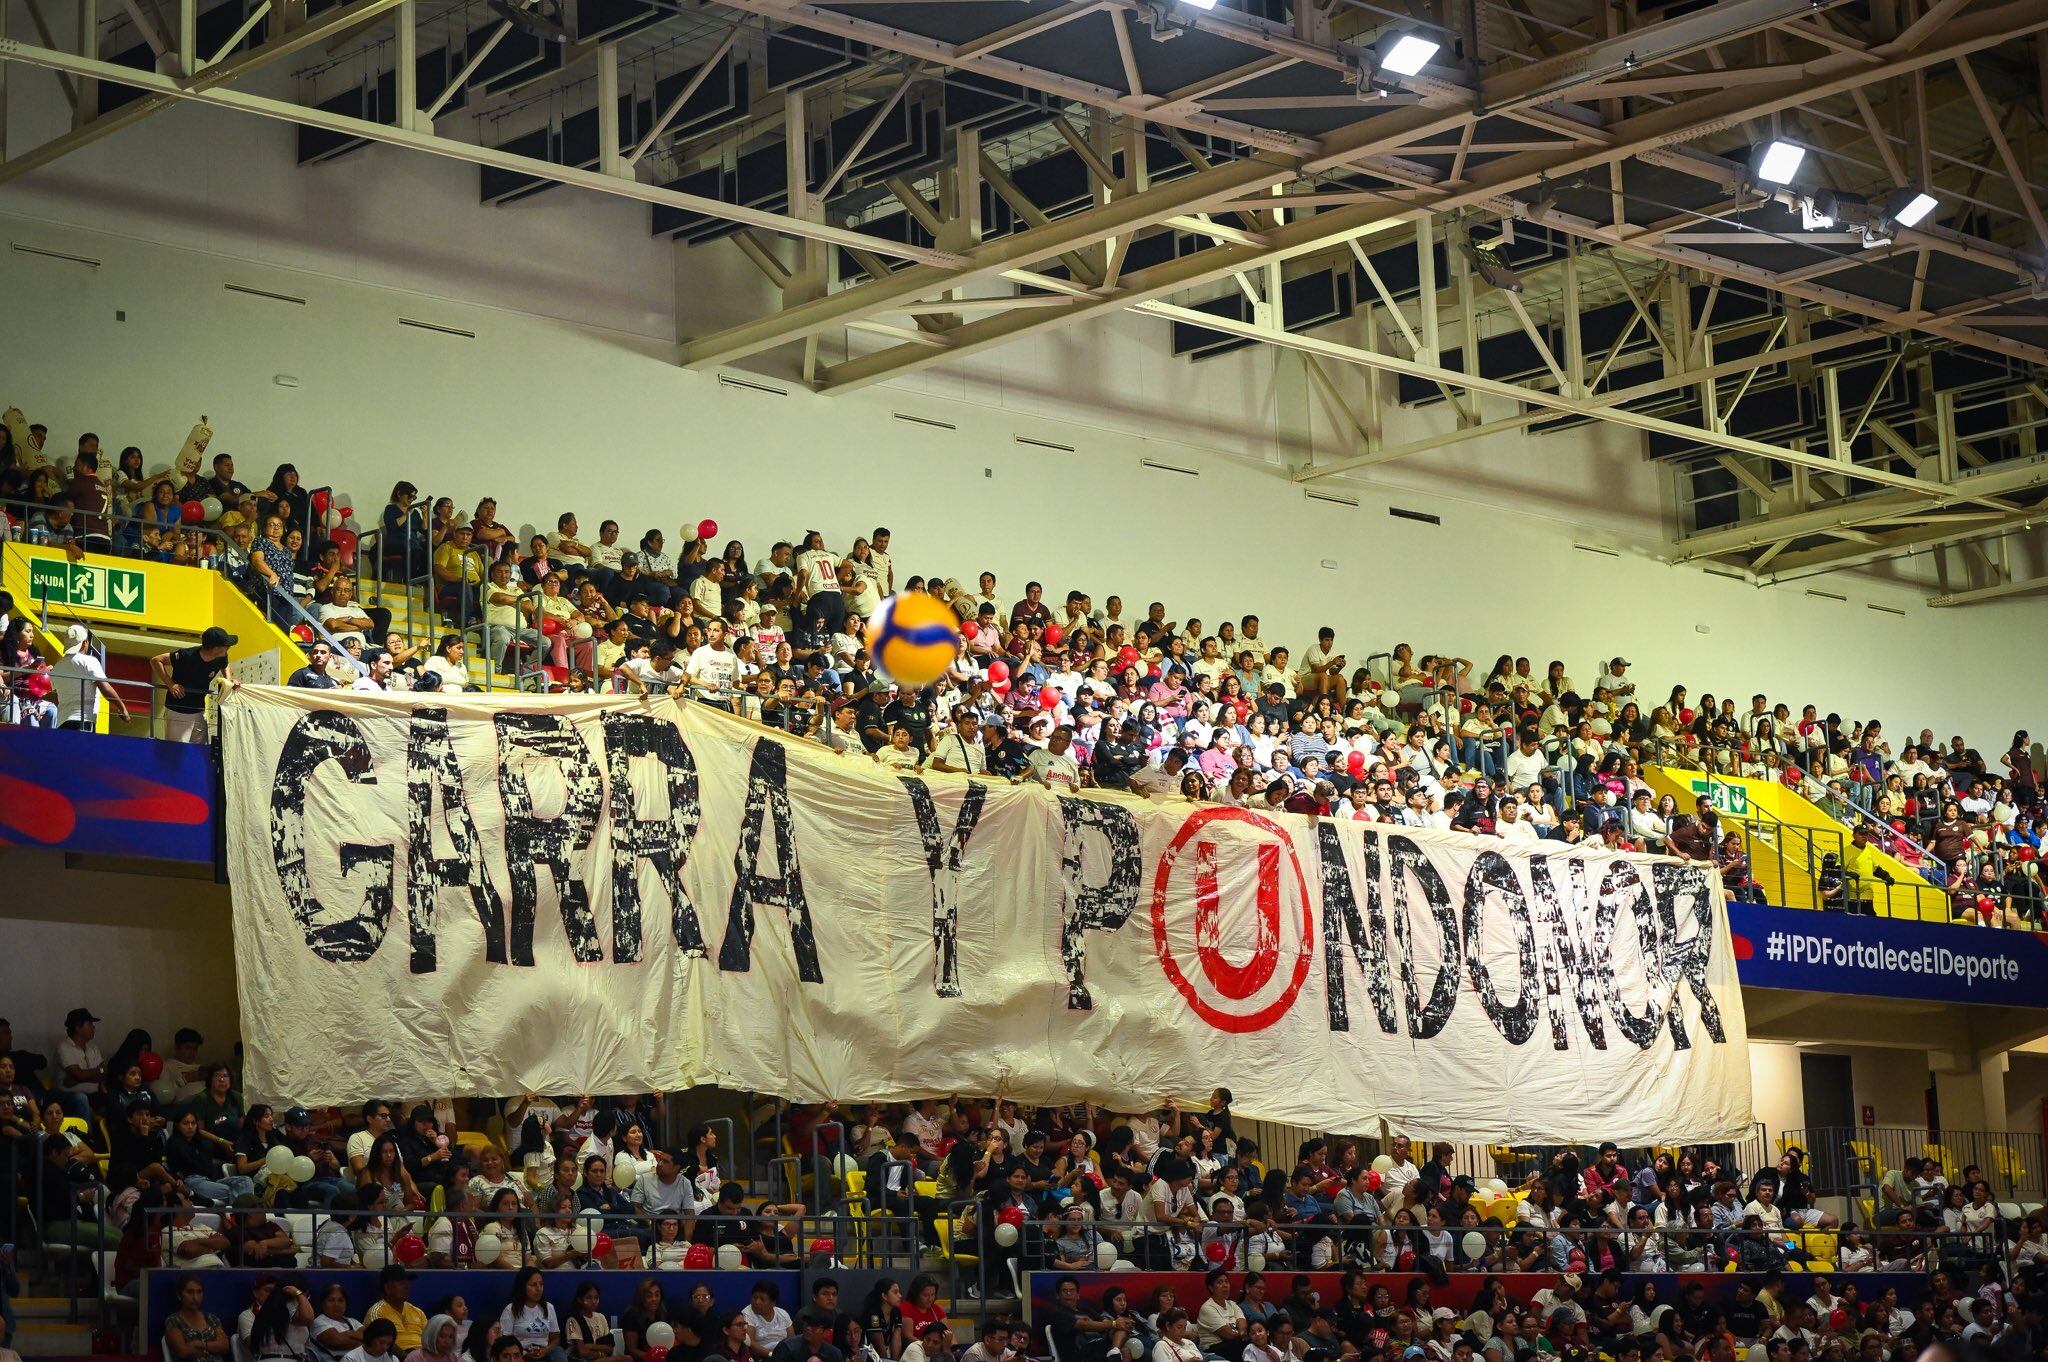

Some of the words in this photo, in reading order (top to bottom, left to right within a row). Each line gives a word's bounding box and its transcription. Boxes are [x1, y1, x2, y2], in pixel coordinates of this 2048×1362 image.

[33, 573, 65, 588] SALIDA
[815, 559, 835, 580] 10
[269, 706, 824, 984] GARRA
[896, 775, 988, 999] Y
[1056, 794, 1727, 1051] PUNDONOR
[1766, 931, 2020, 986] #IPDFortaleceElDeporte
